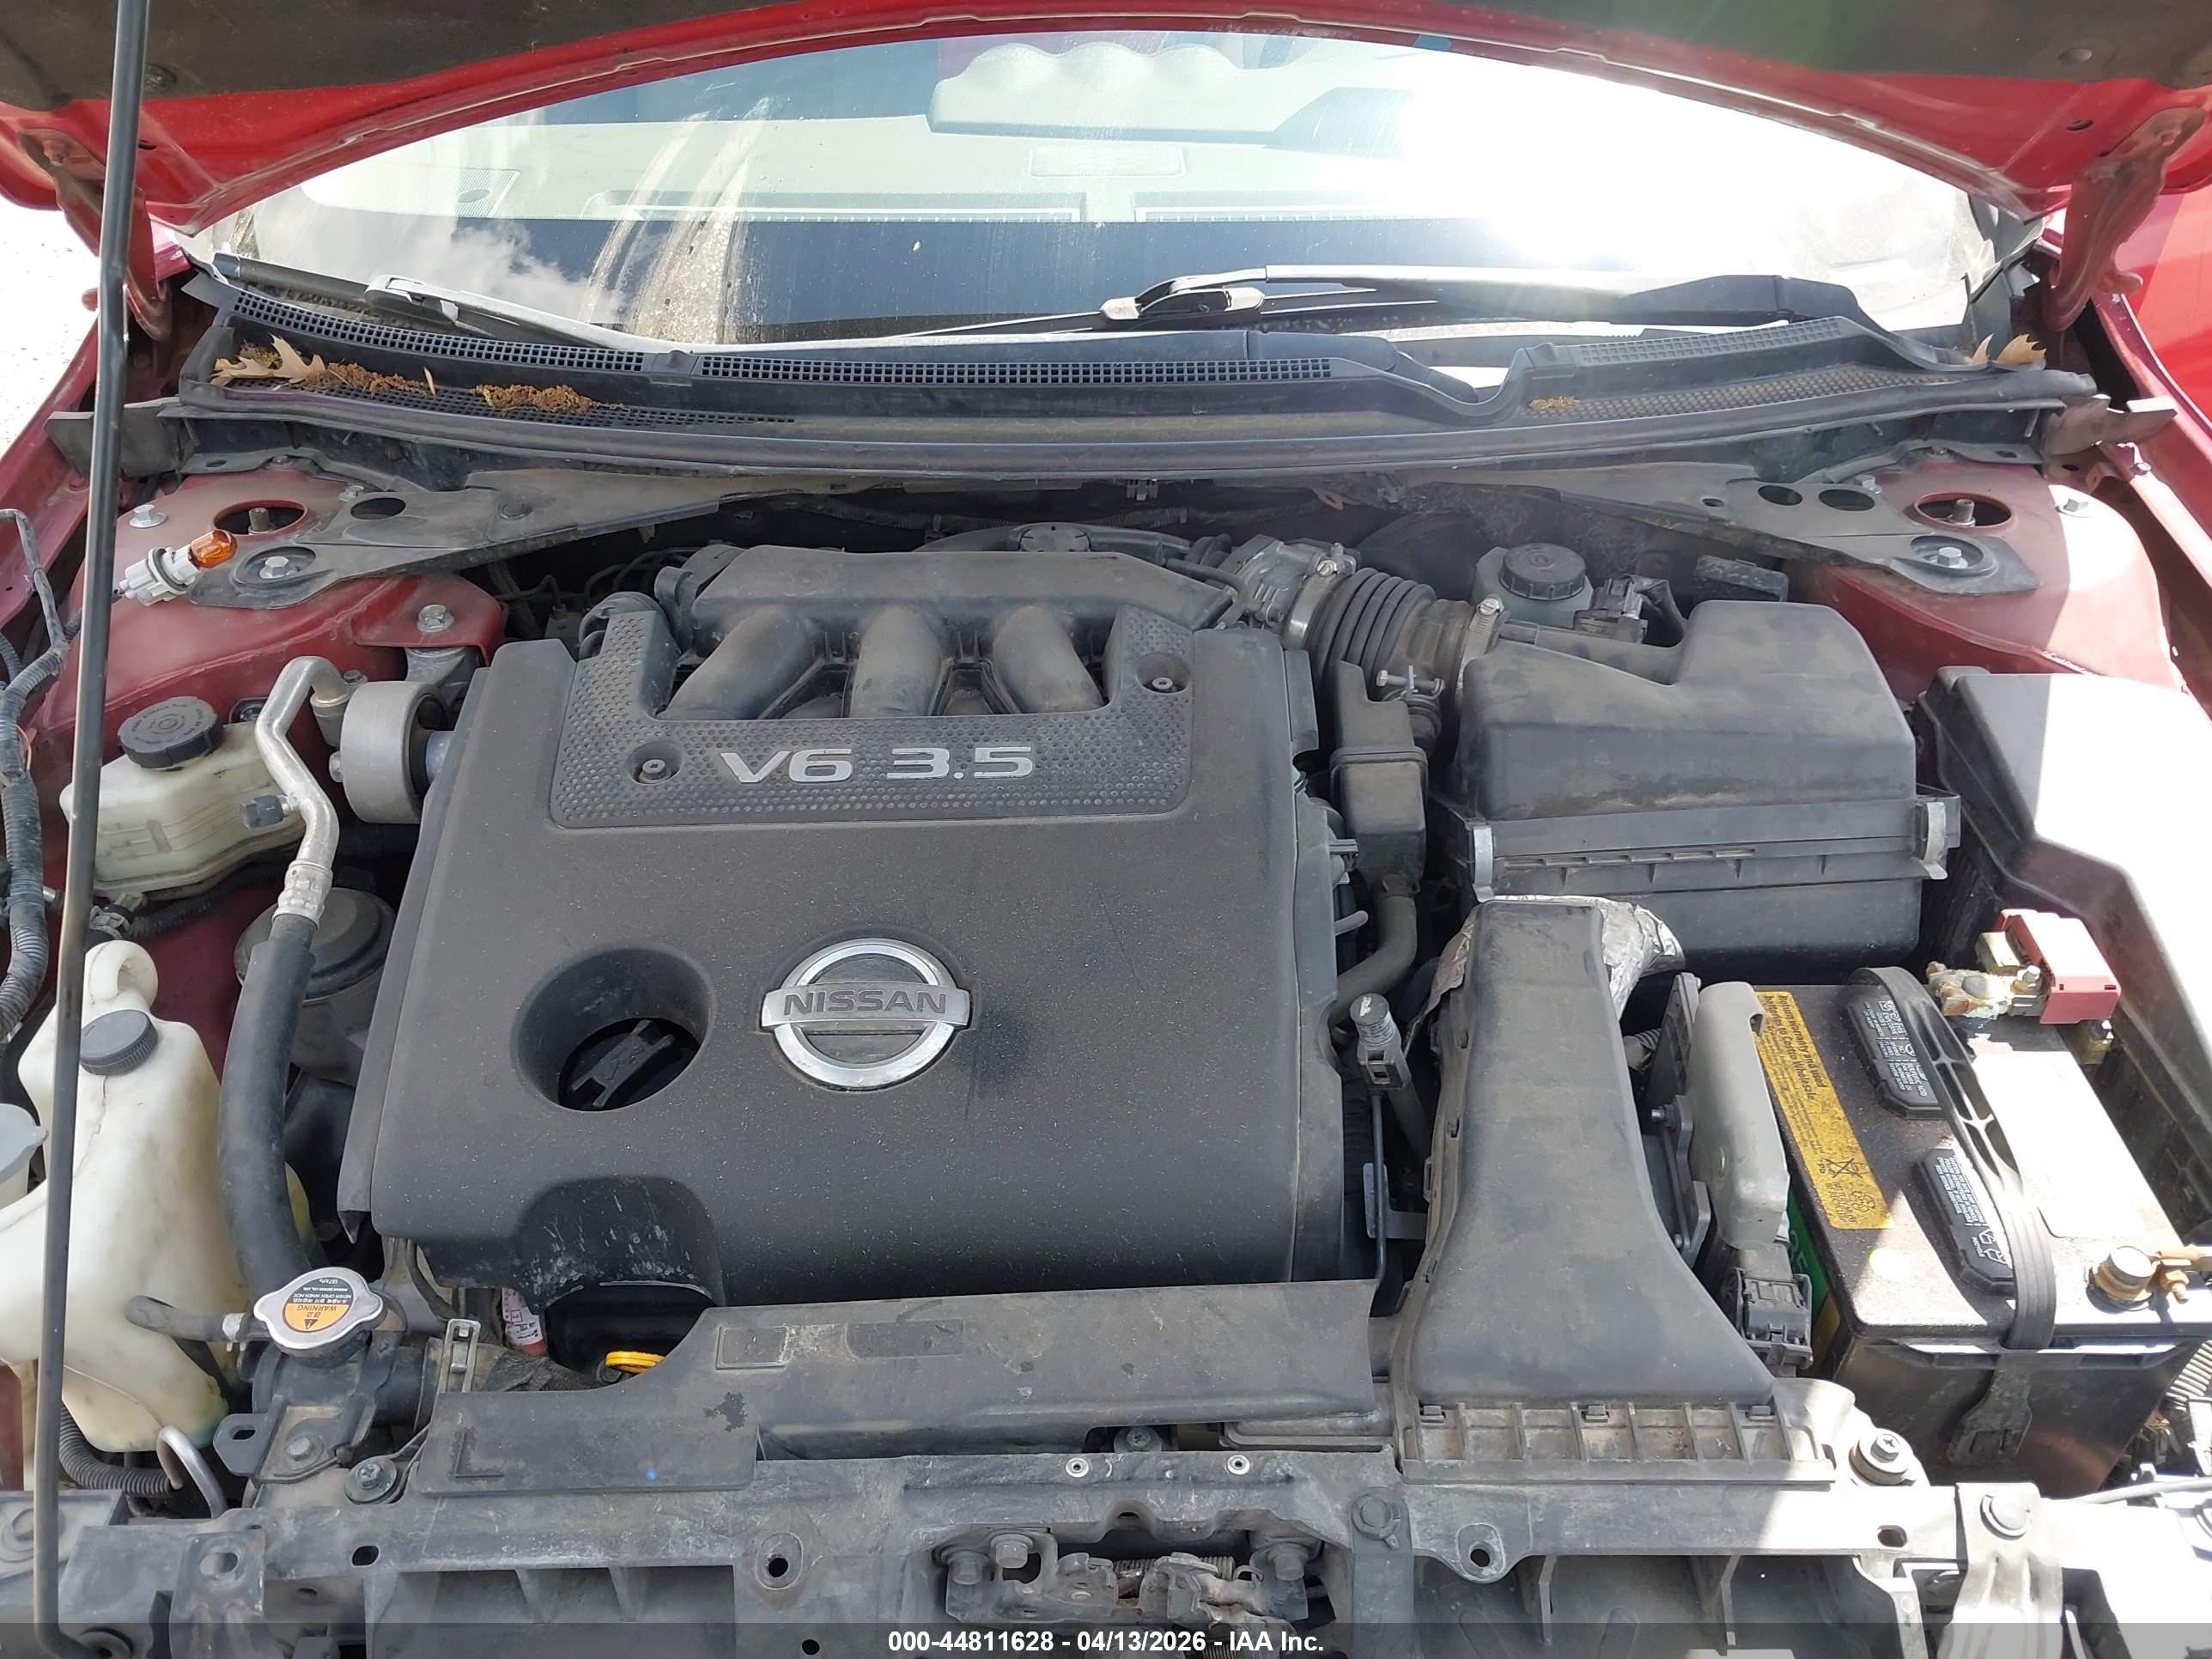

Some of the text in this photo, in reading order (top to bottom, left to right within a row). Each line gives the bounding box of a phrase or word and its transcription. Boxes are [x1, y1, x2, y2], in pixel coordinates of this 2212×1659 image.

[720, 746, 1033, 783] V6 3.5
[783, 989, 946, 1016] NISSAN
[1782, 1036, 1797, 1060] Costco
[1792, 1060, 1817, 1099] Wholesale
